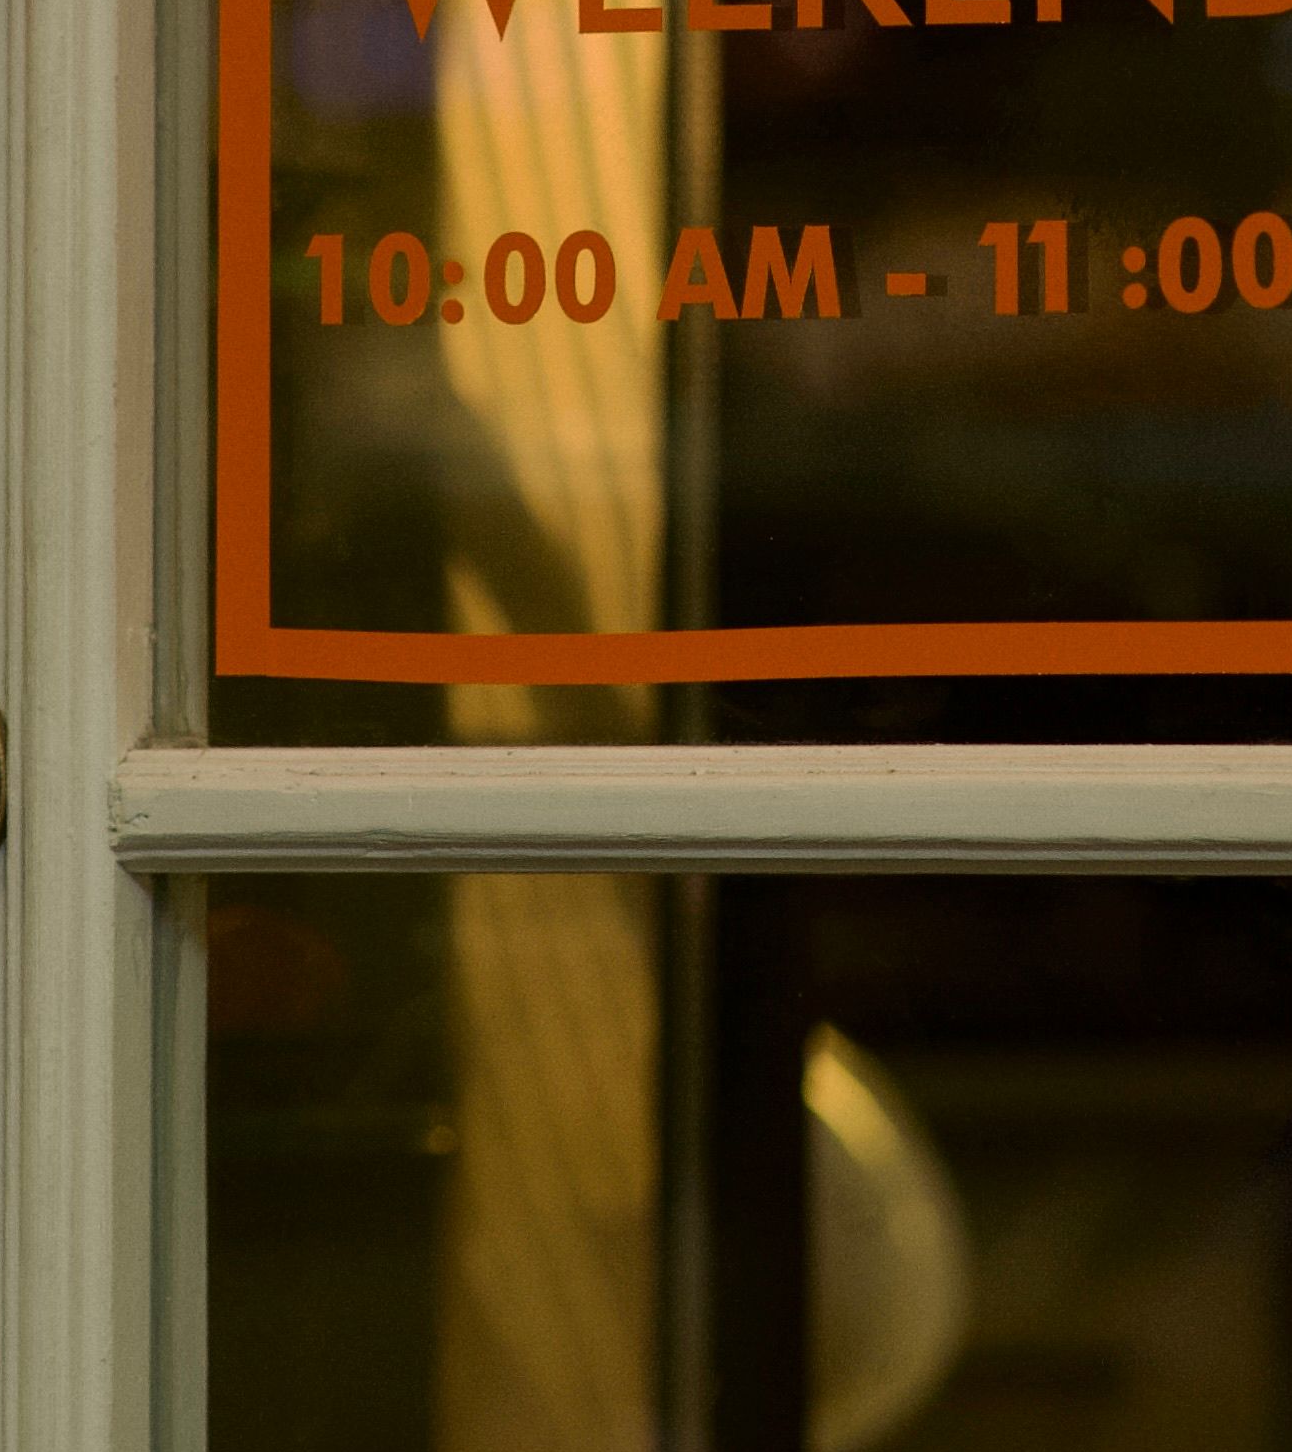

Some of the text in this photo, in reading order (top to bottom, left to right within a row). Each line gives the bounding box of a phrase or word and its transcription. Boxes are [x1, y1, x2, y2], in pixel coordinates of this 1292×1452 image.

[305, 229, 618, 327] 10:00
[654, 224, 842, 323] AM
[885, 272, 927, 297] -
